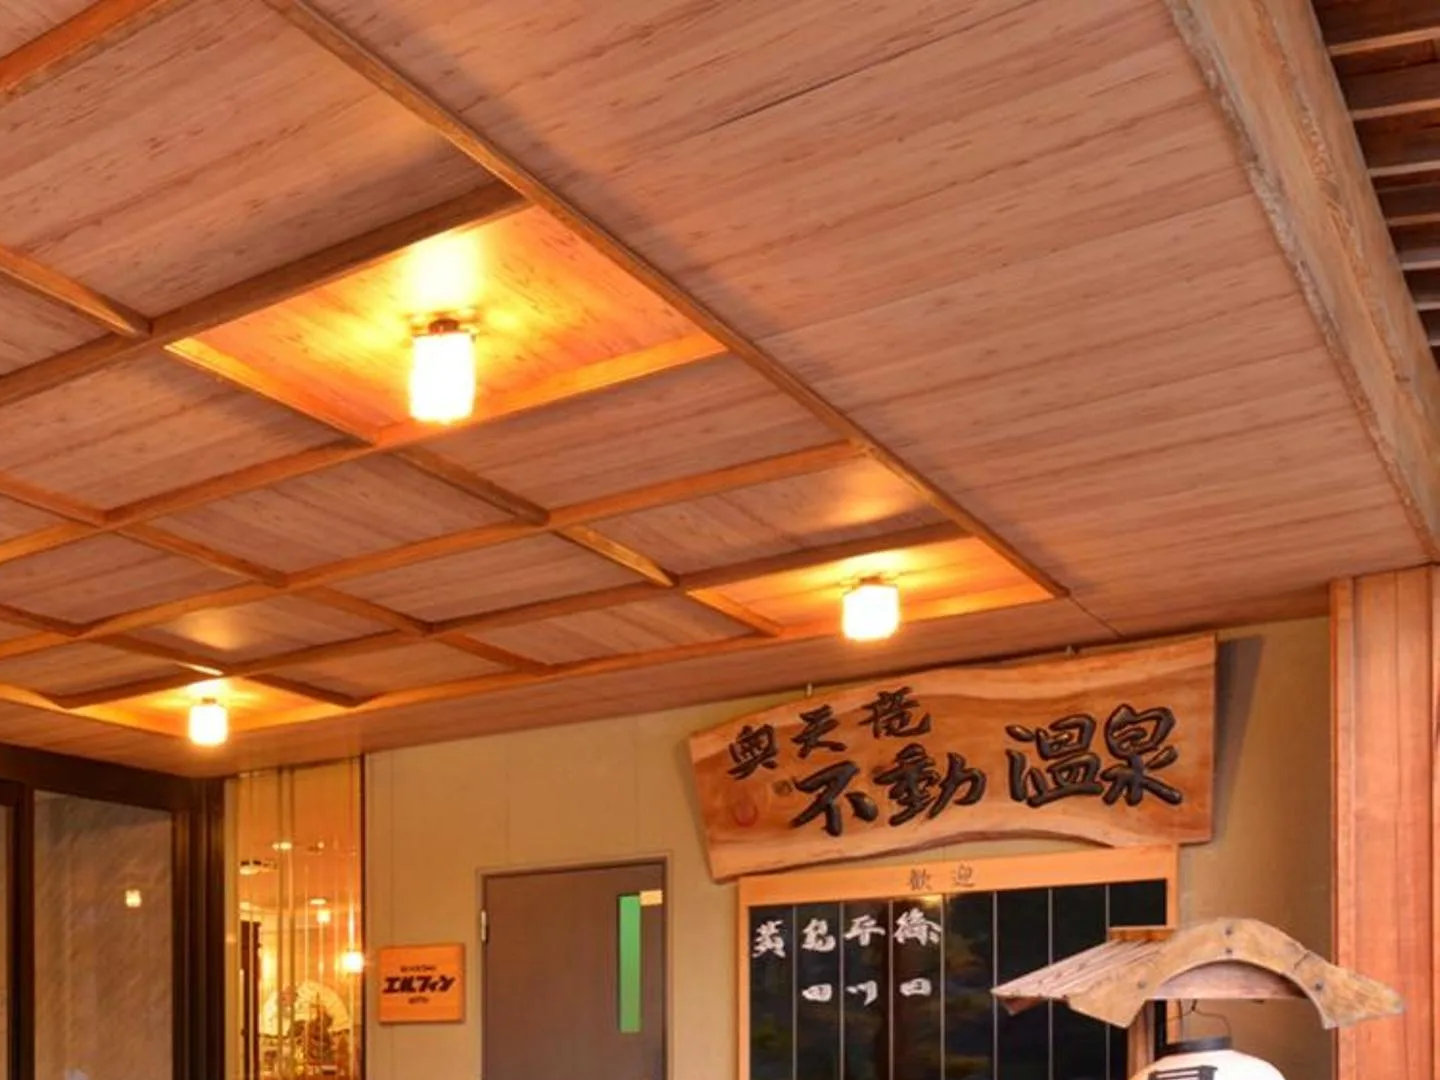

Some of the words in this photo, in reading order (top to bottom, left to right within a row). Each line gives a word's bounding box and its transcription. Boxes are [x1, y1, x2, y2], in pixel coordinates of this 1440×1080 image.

[789, 703, 1183, 837] 不動温泉
[382, 974, 456, 994] エルフィン
